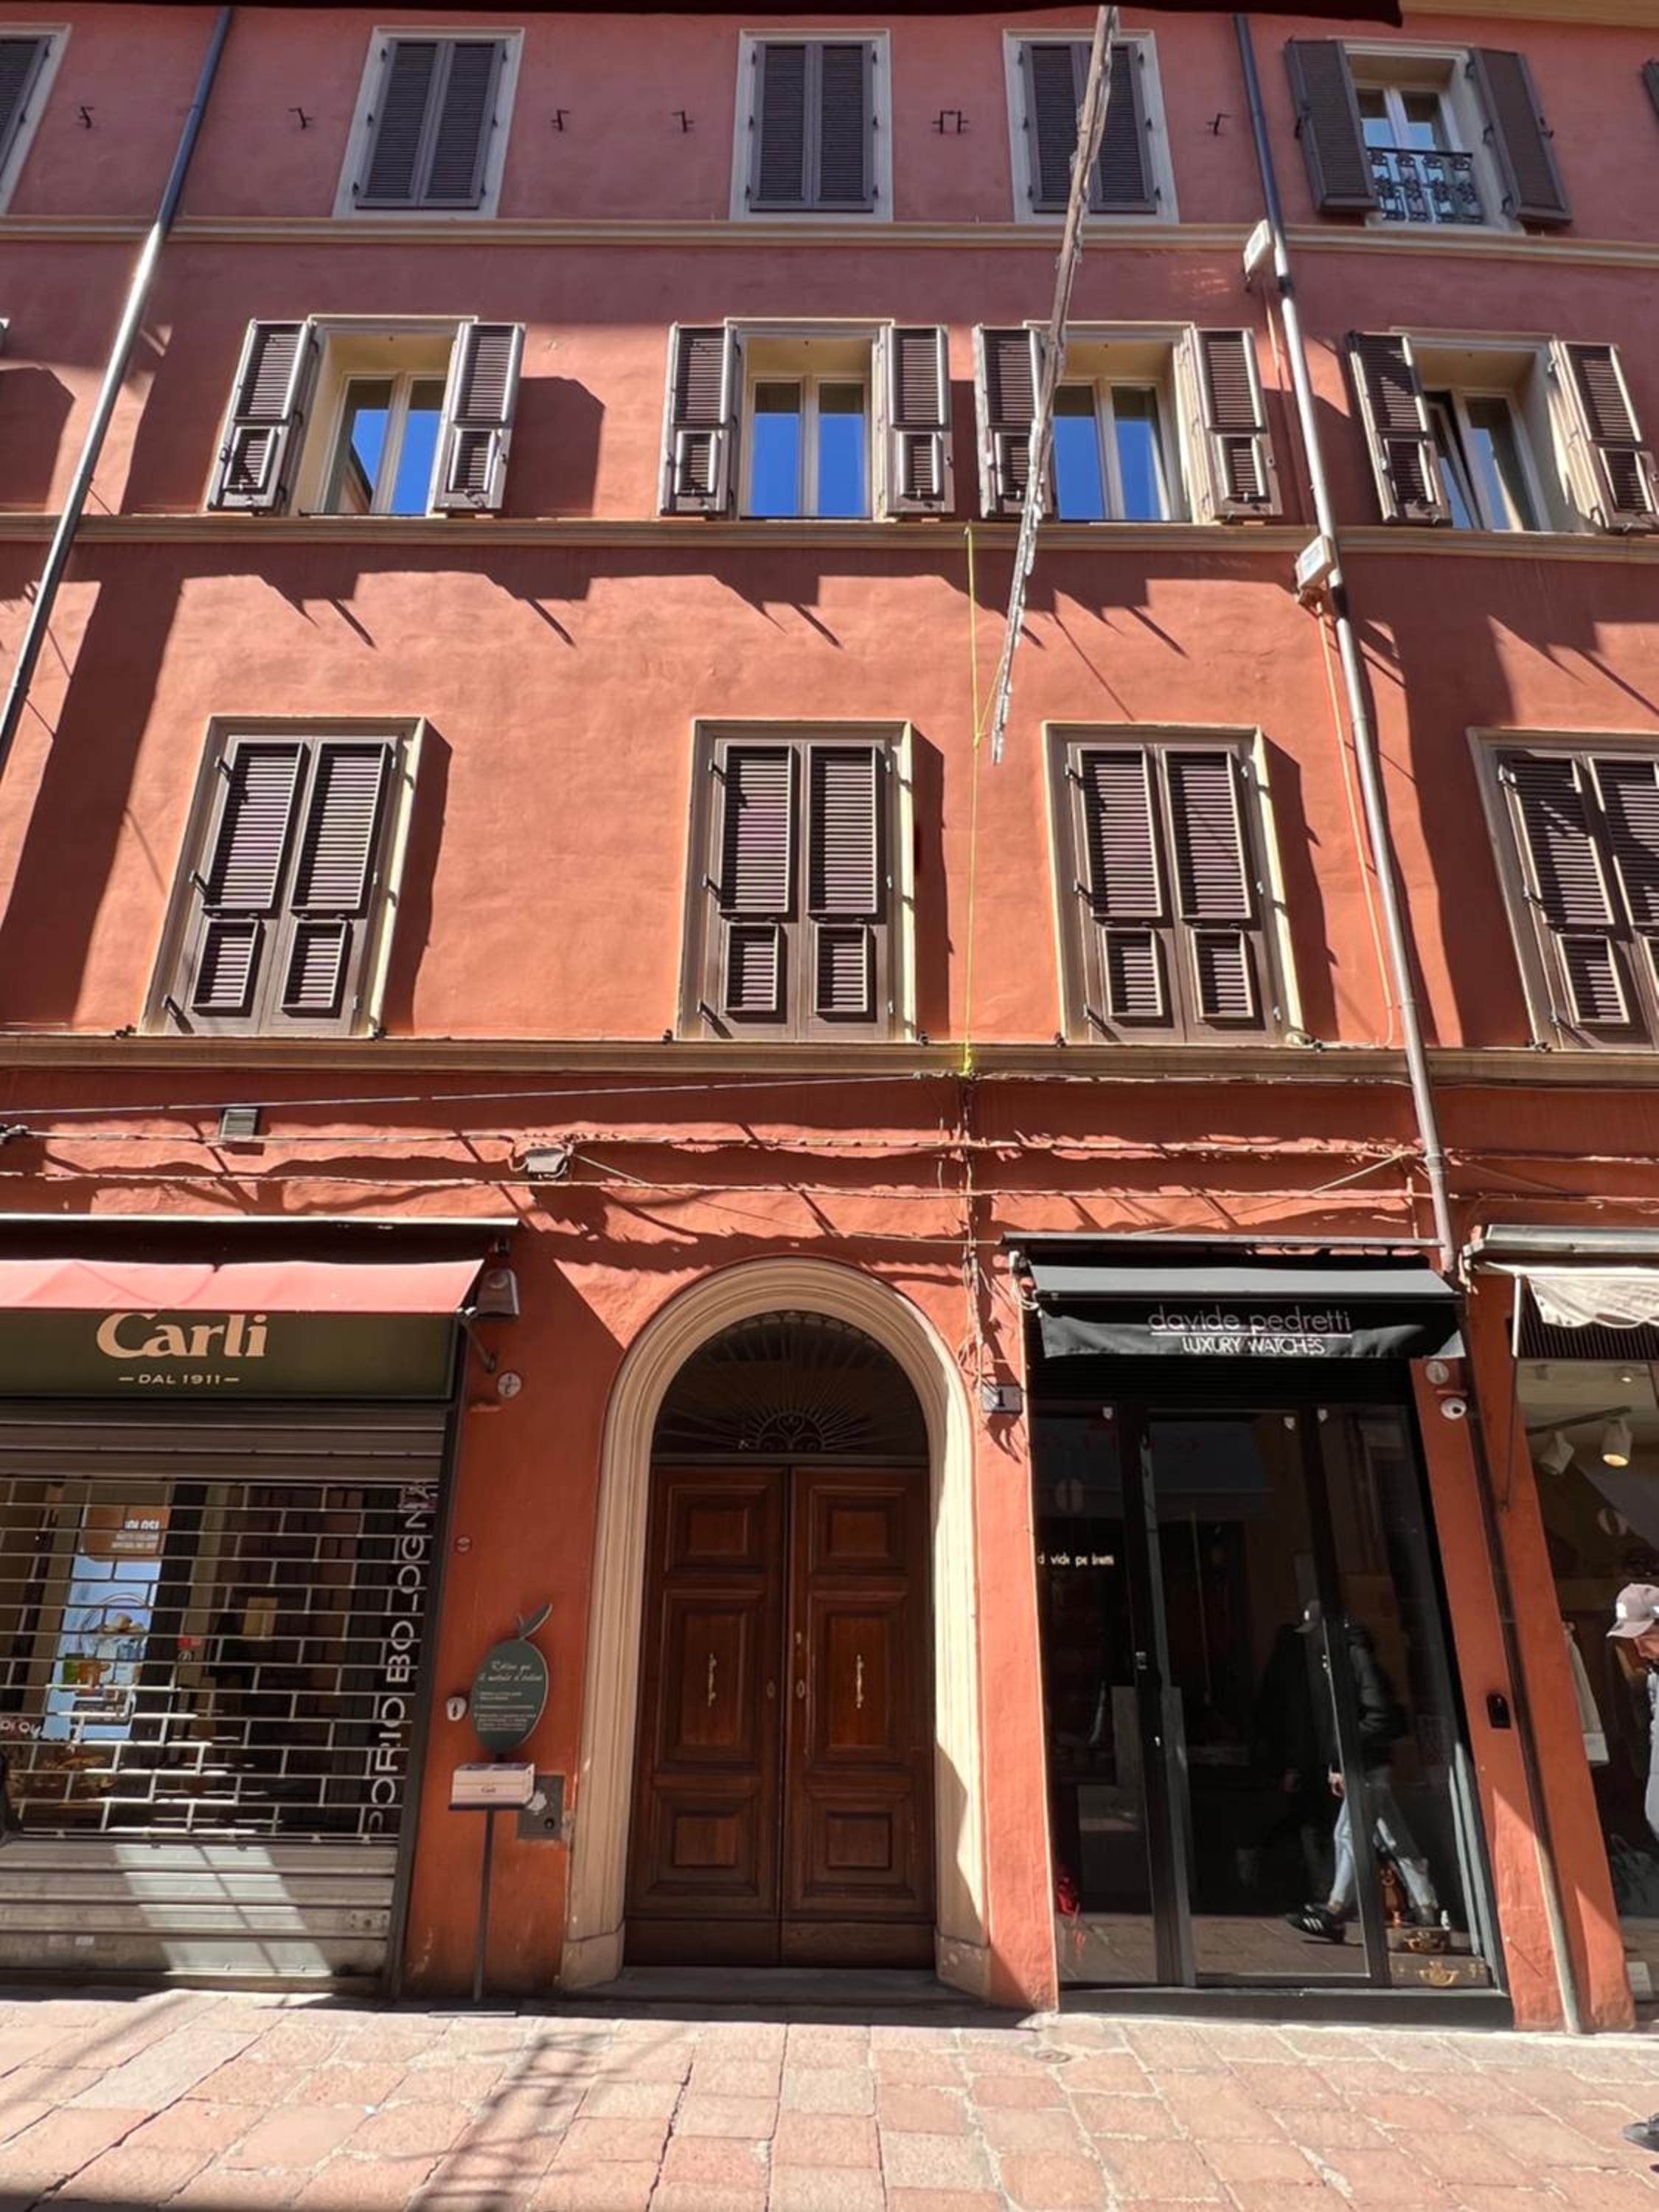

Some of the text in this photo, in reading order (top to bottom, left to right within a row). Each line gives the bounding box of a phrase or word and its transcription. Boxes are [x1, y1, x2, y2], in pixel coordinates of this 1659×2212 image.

[1147, 1304, 1352, 1335] davide pedretti
[96, 1312, 268, 1359] Carli
[1181, 1337, 1325, 1355] LUXURY WATCHES
[138, 1374, 220, 1385] DAL 1911
[998, 1388, 1005, 1408] 1
